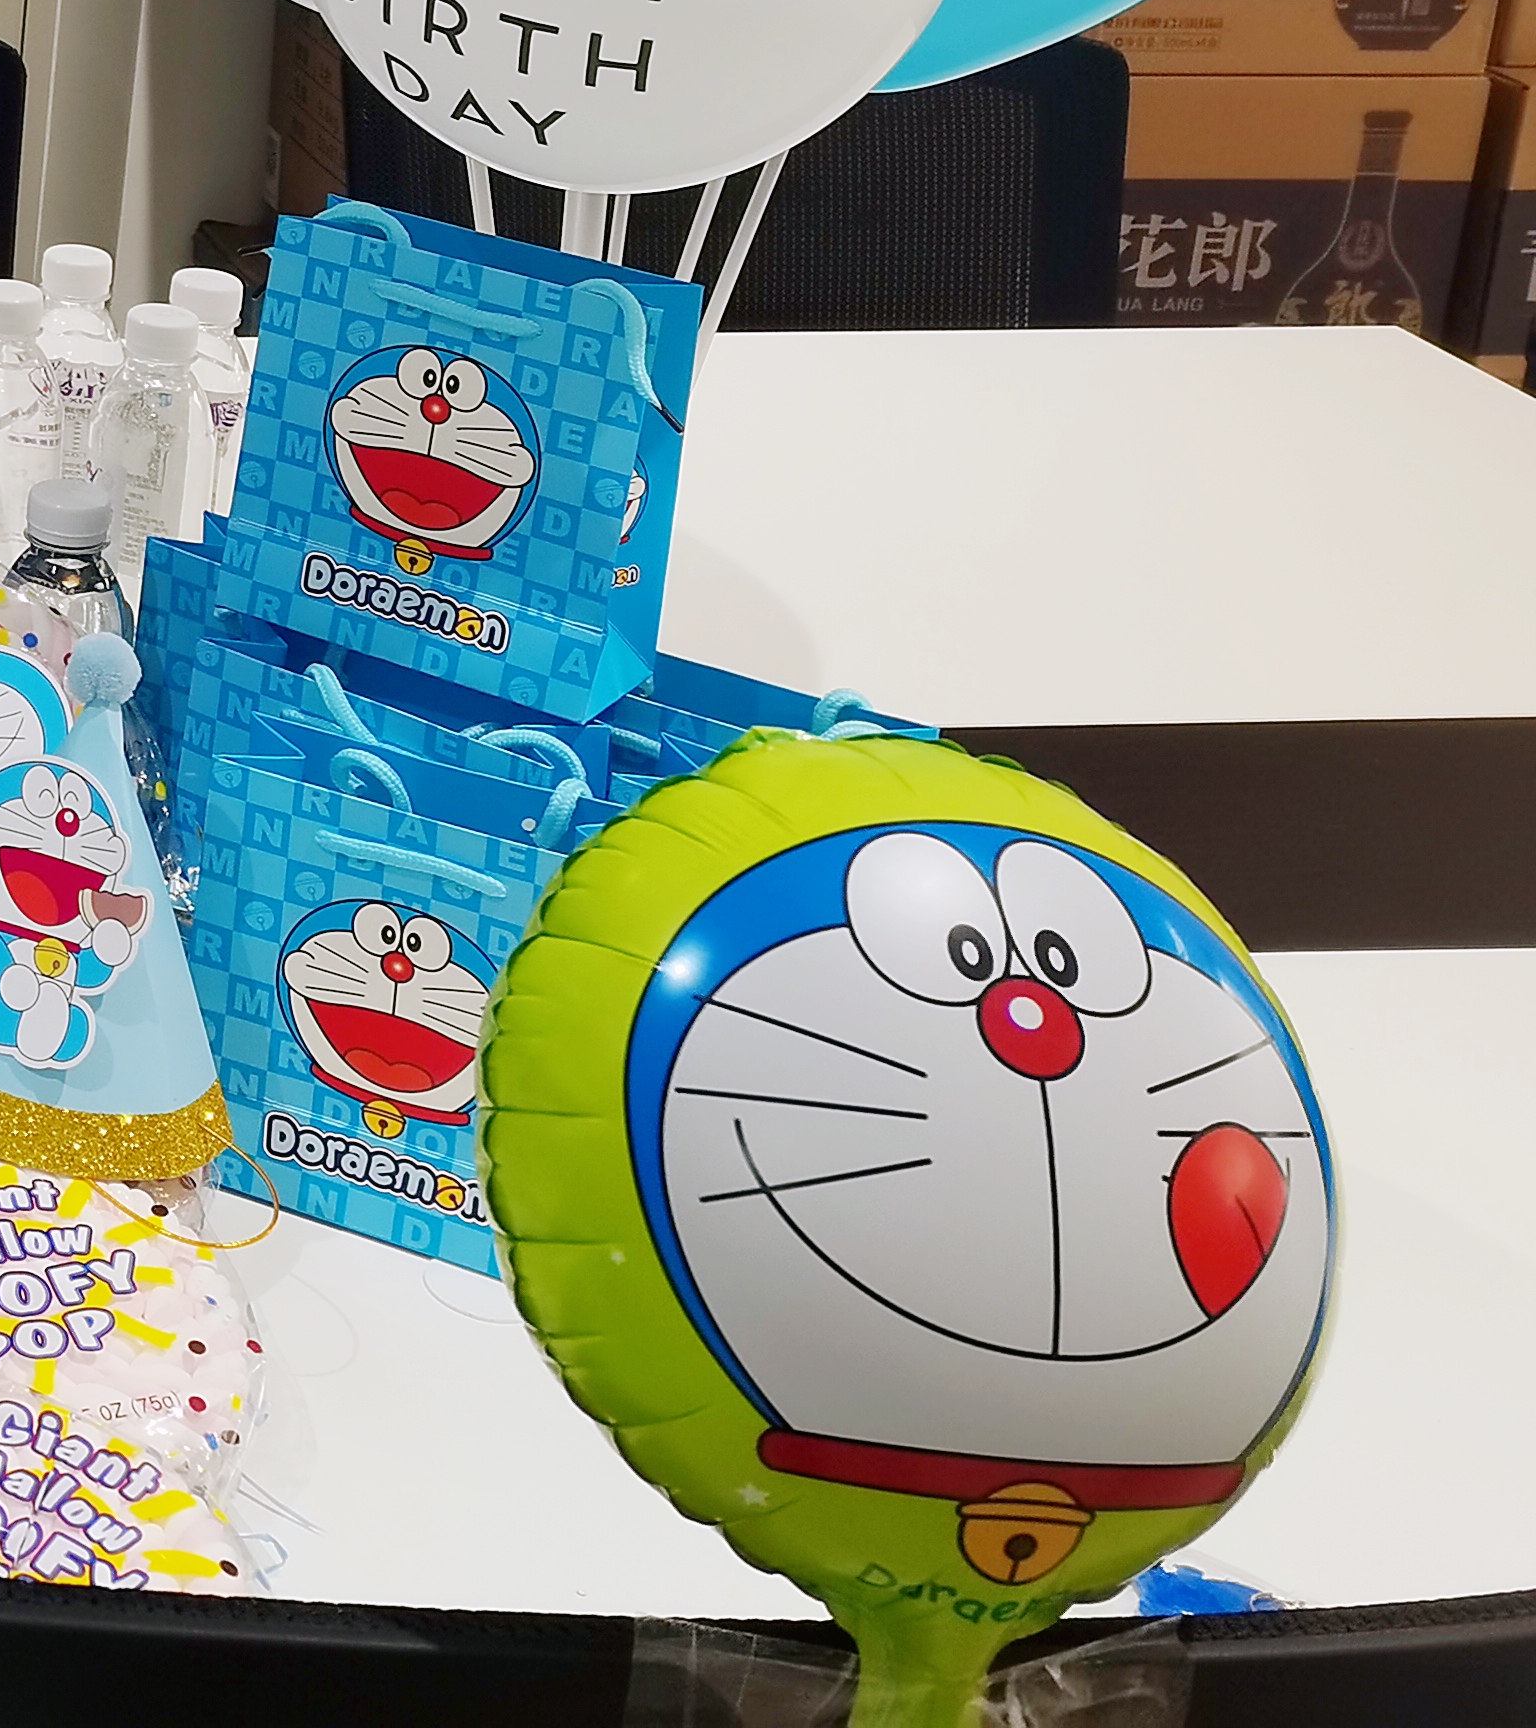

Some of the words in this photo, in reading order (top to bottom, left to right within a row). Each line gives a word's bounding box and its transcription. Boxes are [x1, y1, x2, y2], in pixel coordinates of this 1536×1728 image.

[383, 50, 567, 146] DAY
[1117, 297, 1142, 312] UA
[1152, 297, 1205, 312] LANG
[300, 552, 510, 654] Doraemon
[99, 1401, 128, 1422] OZ
